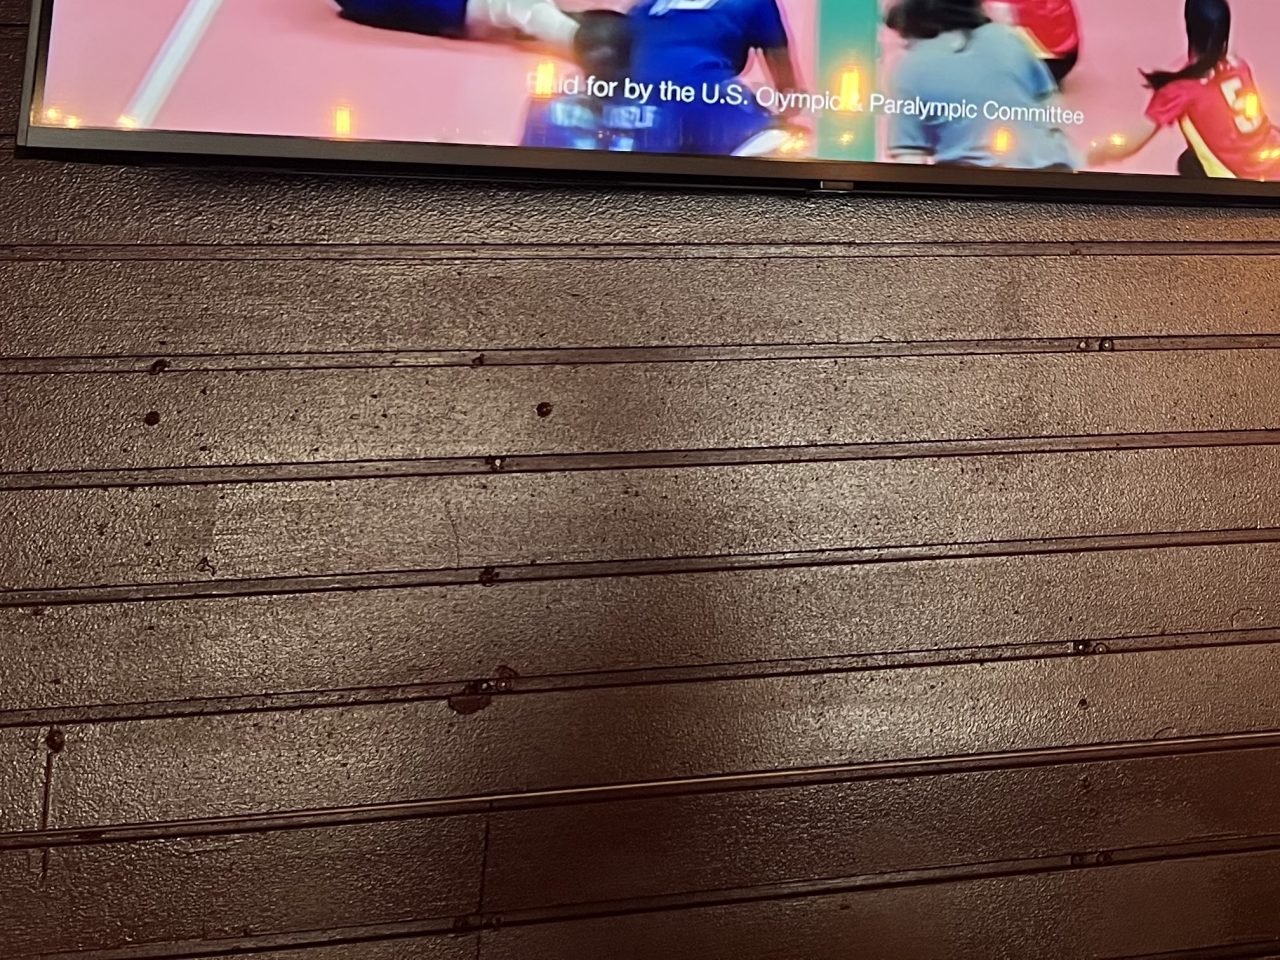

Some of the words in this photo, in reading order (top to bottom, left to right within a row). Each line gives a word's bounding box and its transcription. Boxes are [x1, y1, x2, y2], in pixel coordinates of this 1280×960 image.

[585, 74, 618, 98] for
[623, 77, 653, 104] by
[659, 79, 695, 103] the
[702, 82, 749, 106] U.S.
[755, 86, 842, 114] Olympic
[870, 93, 978, 121] Paralympic
[983, 99, 1085, 124] Committee
